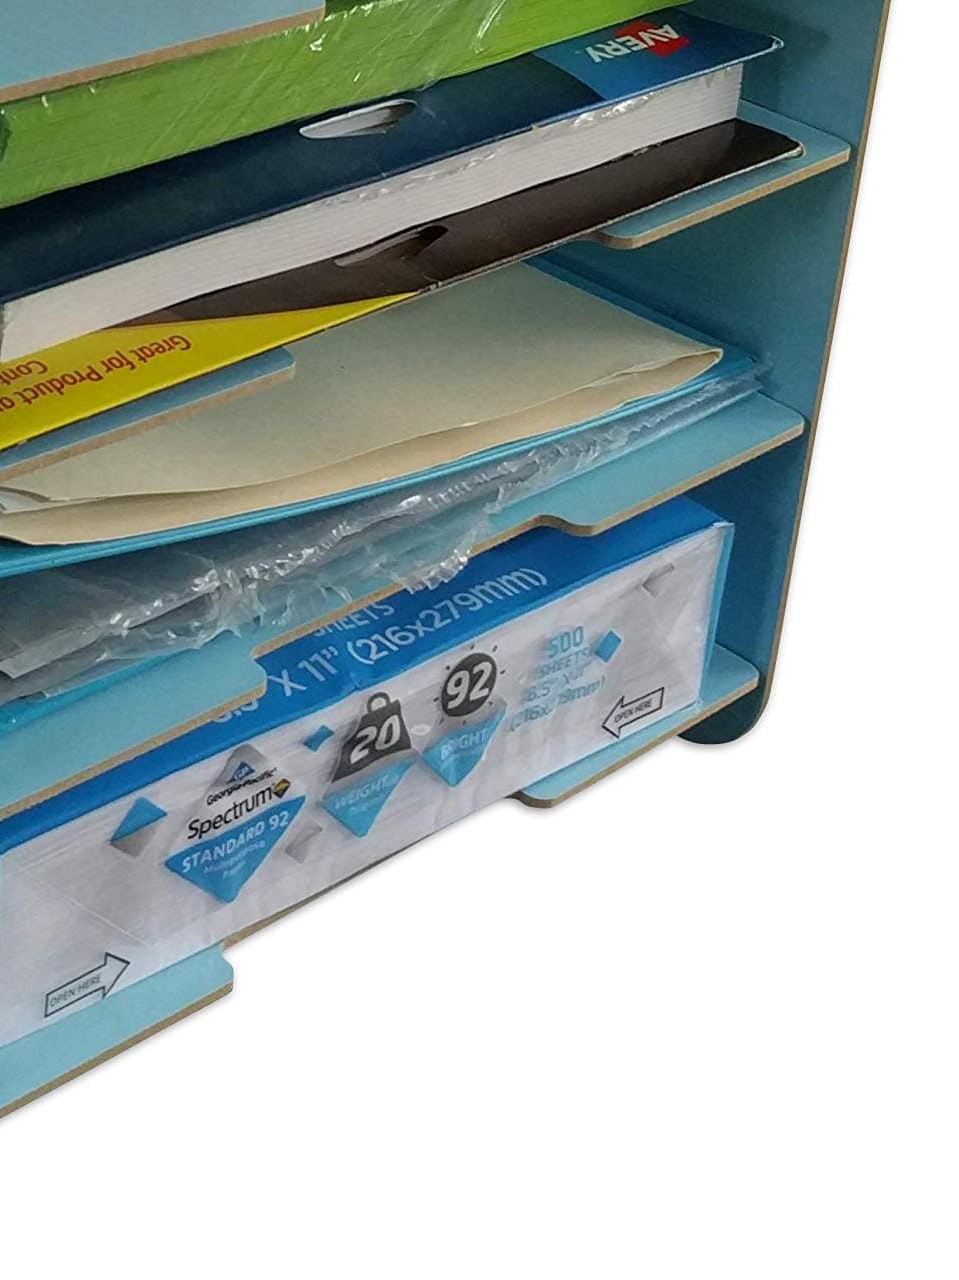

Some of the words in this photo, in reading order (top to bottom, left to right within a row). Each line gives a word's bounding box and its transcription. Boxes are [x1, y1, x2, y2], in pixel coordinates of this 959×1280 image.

[584, 24, 681, 63] AVERY
[103, 350, 136, 371] for
[130, 335, 192, 361] Great
[14, 366, 103, 405] Product
[267, 669, 308, 697] X
[346, 568, 548, 665] (216x279mm)
[446, 661, 493, 710] 92
[349, 715, 401, 765] 20
[187, 786, 272, 839] Spectrum
[182, 821, 265, 873] STANDARD
[268, 811, 289, 830] 92
[49, 988, 76, 1007] OPEN
